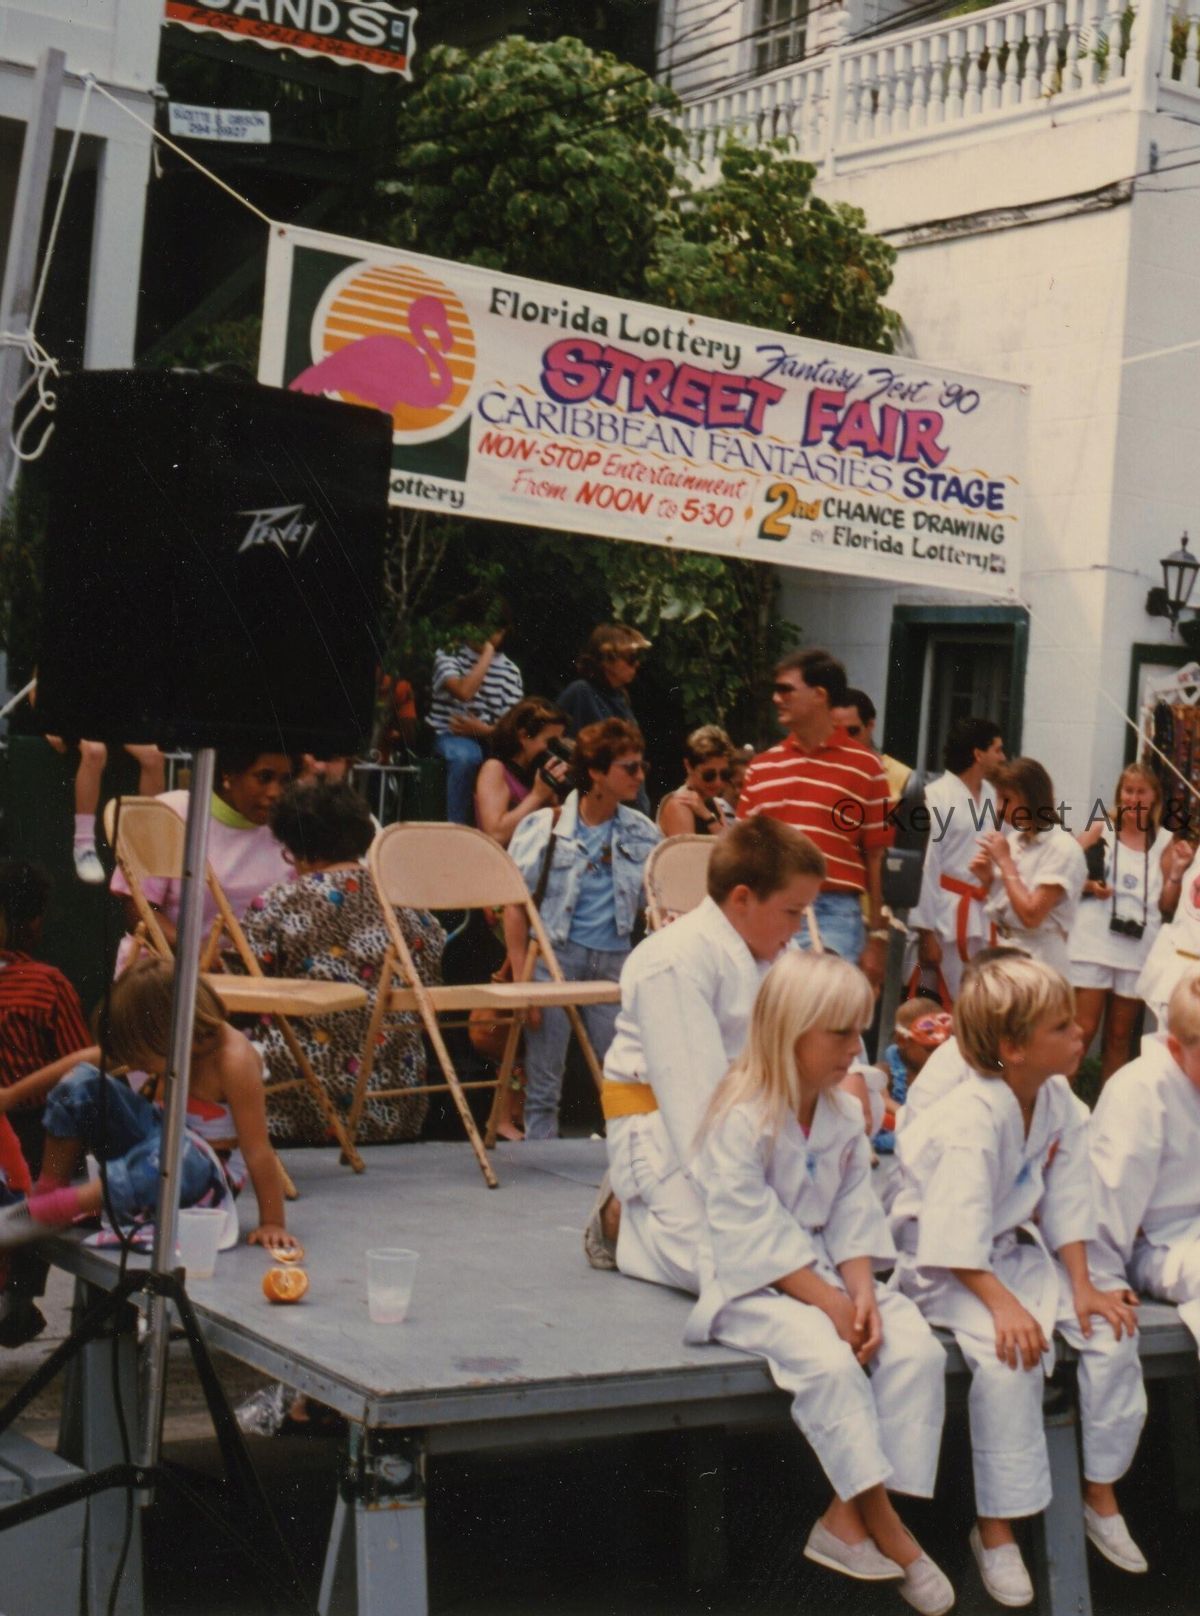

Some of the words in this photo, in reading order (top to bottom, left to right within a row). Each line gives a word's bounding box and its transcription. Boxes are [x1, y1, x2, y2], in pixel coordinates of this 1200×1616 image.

[197, 0, 387, 46] ANDS
[488, 287, 608, 337] Florida
[618, 313, 742, 370] Lottery
[756, 345, 863, 391] Fantasy
[865, 368, 932, 402] Fest
[541, 338, 786, 435] STREET
[801, 387, 950, 468] FAIR
[478, 391, 695, 458] CARIBBEAN
[708, 432, 893, 492] FANTASIES
[902, 468, 1005, 510] STAGE
[478, 431, 603, 472] NON-STOP
[602, 453, 748, 500] Entertainment
[391, 477, 465, 509] ottery
[512, 467, 569, 502] From
[575, 480, 654, 516] NOON
[657, 499, 679, 518] to
[680, 499, 734, 528] 5:30
[758, 482, 822, 542] 2nd
[823, 497, 905, 530] CHANCE
[913, 511, 1005, 545] DRAWING
[832, 525, 904, 556] Florida
[912, 536, 988, 573] Lottery
